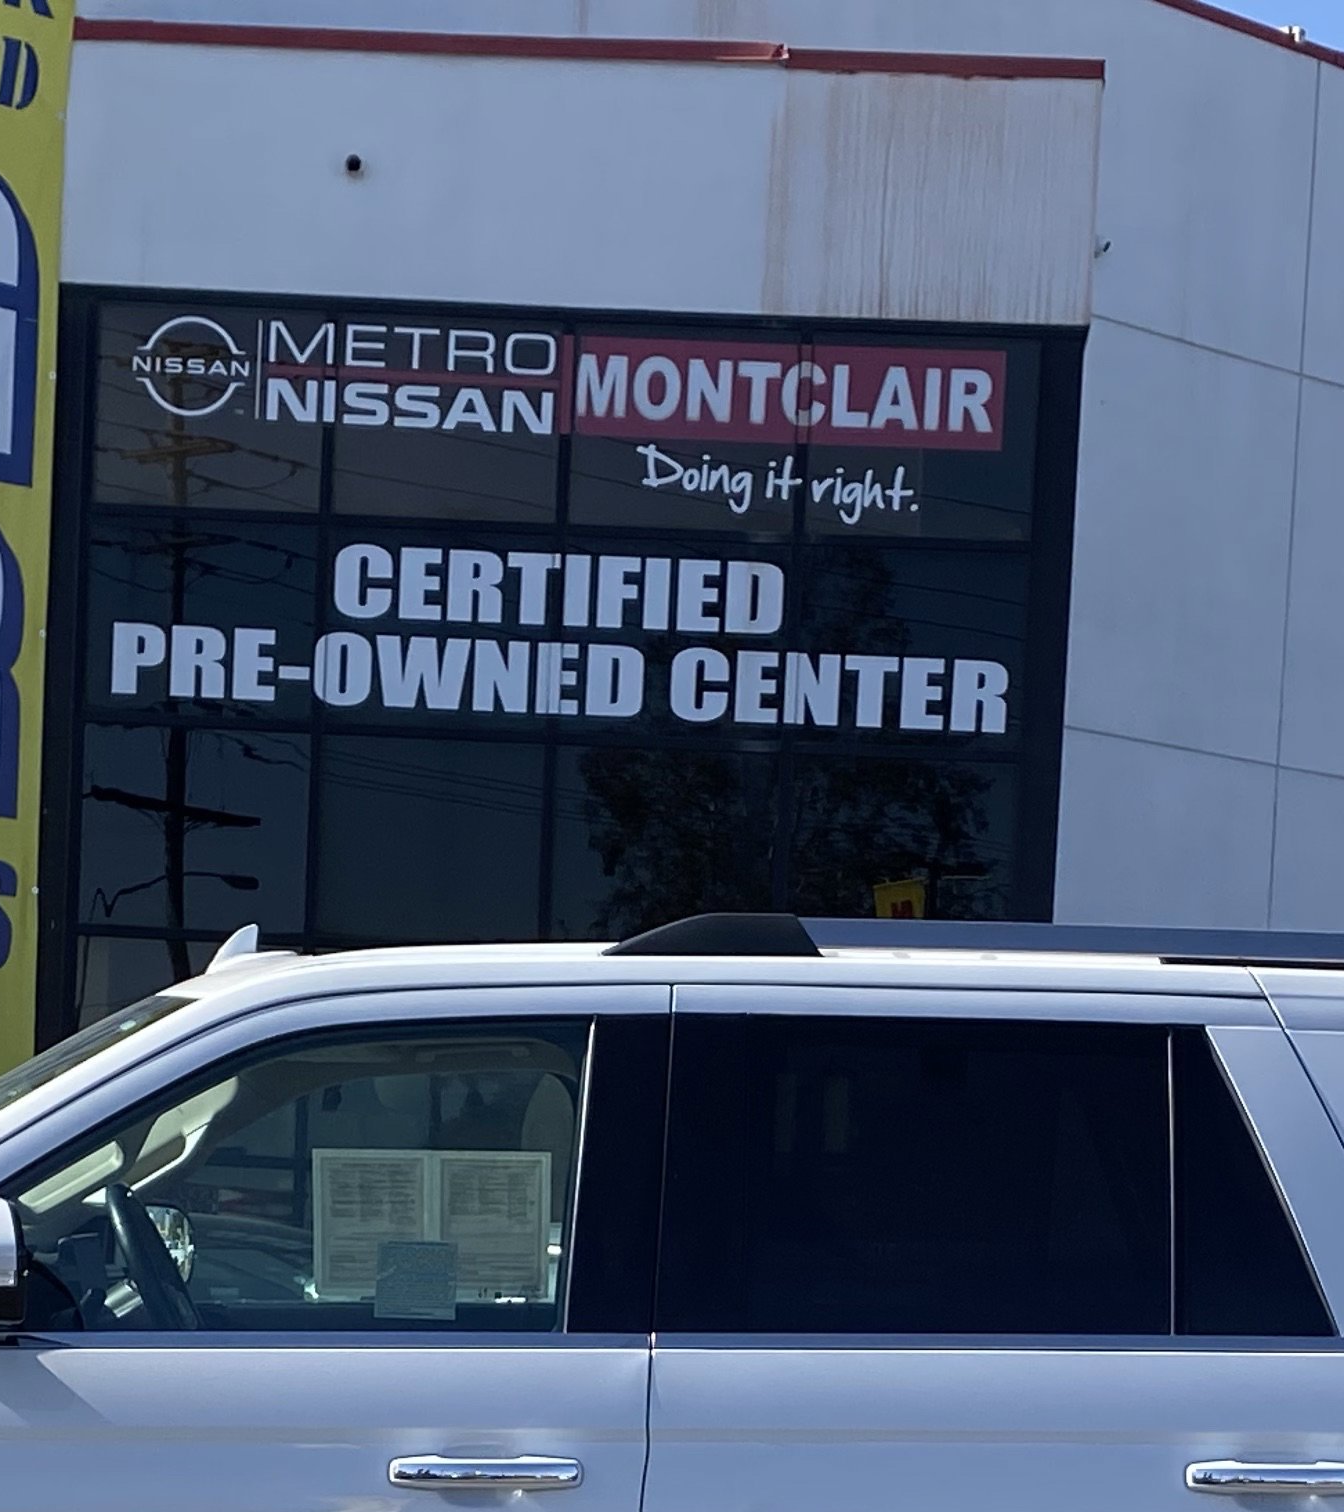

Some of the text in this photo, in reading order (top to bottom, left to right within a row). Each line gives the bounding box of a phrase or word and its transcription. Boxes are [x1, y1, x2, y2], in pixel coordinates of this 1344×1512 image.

[132, 354, 250, 378] NISSAN
[265, 376, 555, 436] NISSAN
[267, 319, 995, 434] METRO MONTCLAIR
[635, 443, 920, 526] Doing it right.
[331, 542, 787, 637] CERTIFIED
[109, 620, 1011, 734] PRE-OWNED CENTER
